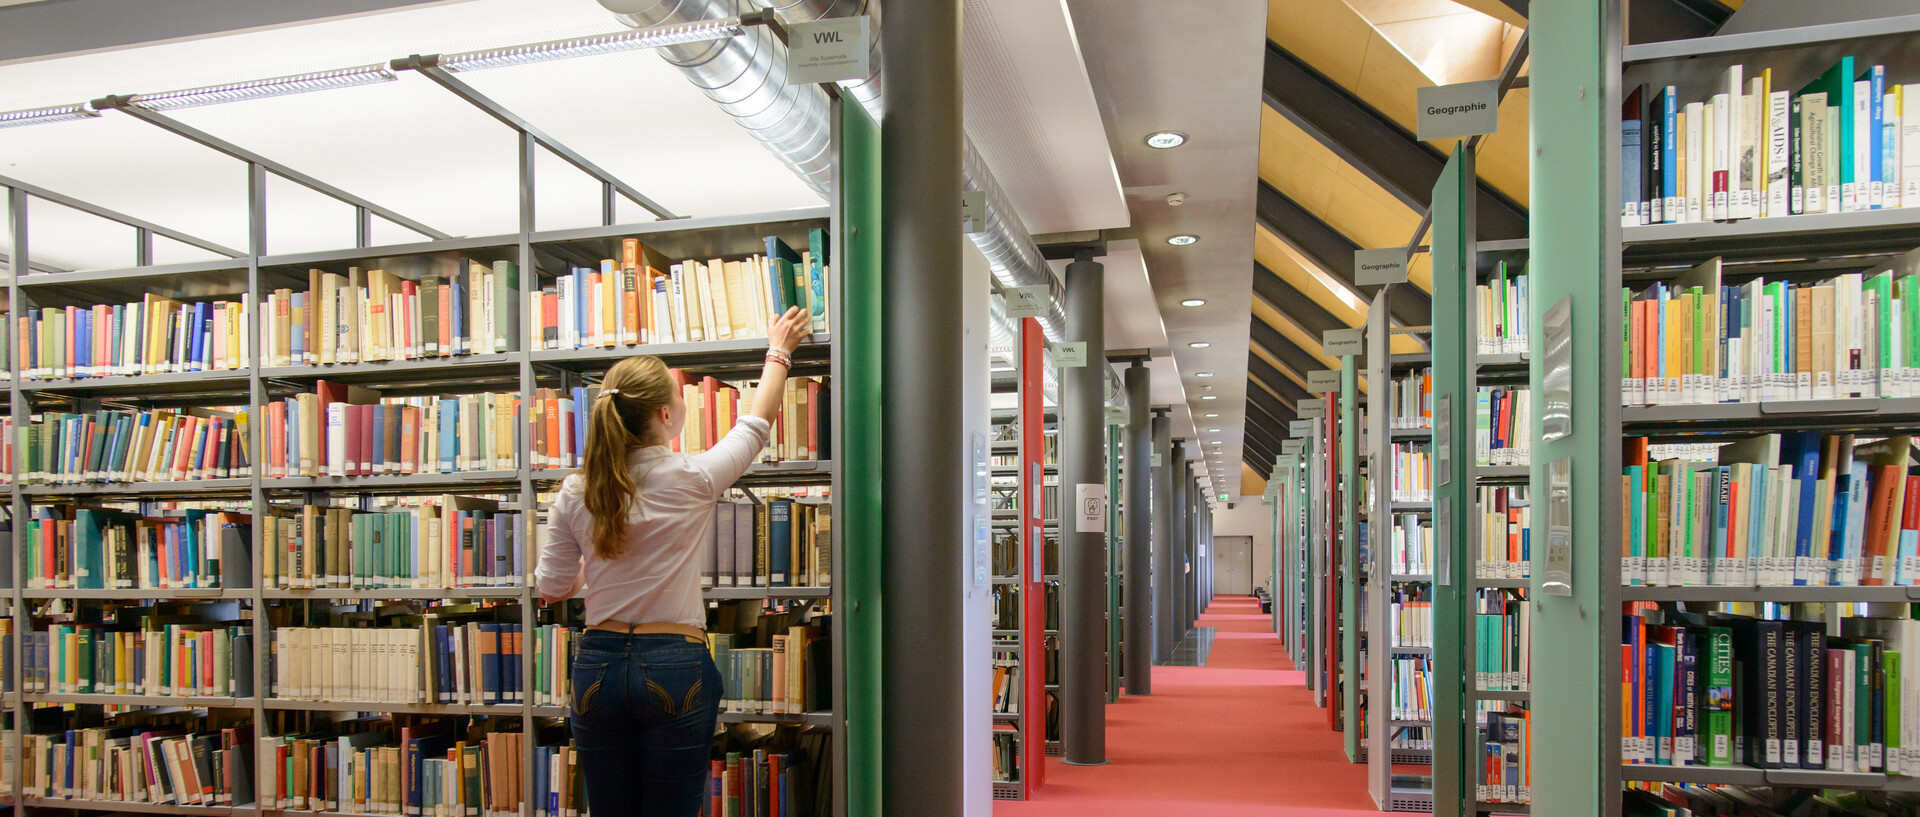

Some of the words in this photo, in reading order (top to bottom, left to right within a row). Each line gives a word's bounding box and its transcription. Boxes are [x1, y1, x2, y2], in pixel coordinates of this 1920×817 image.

[813, 31, 844, 44] VWL
[1427, 102, 1488, 115] Geographie
[1807, 112, 1817, 145] Agricultural
[1815, 119, 1825, 150] Population
[1807, 147, 1817, 169] Change
[1815, 151, 1825, 174] Growth
[1808, 177, 1818, 188] Afri
[1816, 174, 1824, 186] and
[1361, 263, 1401, 272] Geographie
[1019, 292, 1036, 300] VWL
[1328, 339, 1358, 348] Geographie
[1720, 472, 1728, 504] HARARE
[757, 509, 765, 533] Johann
[1767, 631, 1777, 647] THE
[1785, 630, 1795, 647] THE
[1811, 631, 1820, 647] THE
[1718, 633, 1731, 674] CITIES
[1767, 647, 1777, 690] CANADIAN
[1786, 647, 1795, 689] CANADIAN
[1810, 647, 1820, 690] CANADIAN
[1646, 679, 1654, 700] NORTH
[1833, 680, 1843, 705] Regional
[1646, 700, 1654, 726] AMERICA
[1686, 708, 1695, 730] AMERICA
[1767, 690, 1778, 740] ENCYCLOPEDI
[1786, 690, 1796, 740] ENCYCLOPEDI
[1809, 690, 1820, 740] ENCYCLOPEDI
[1833, 705, 1842, 735] Geography
